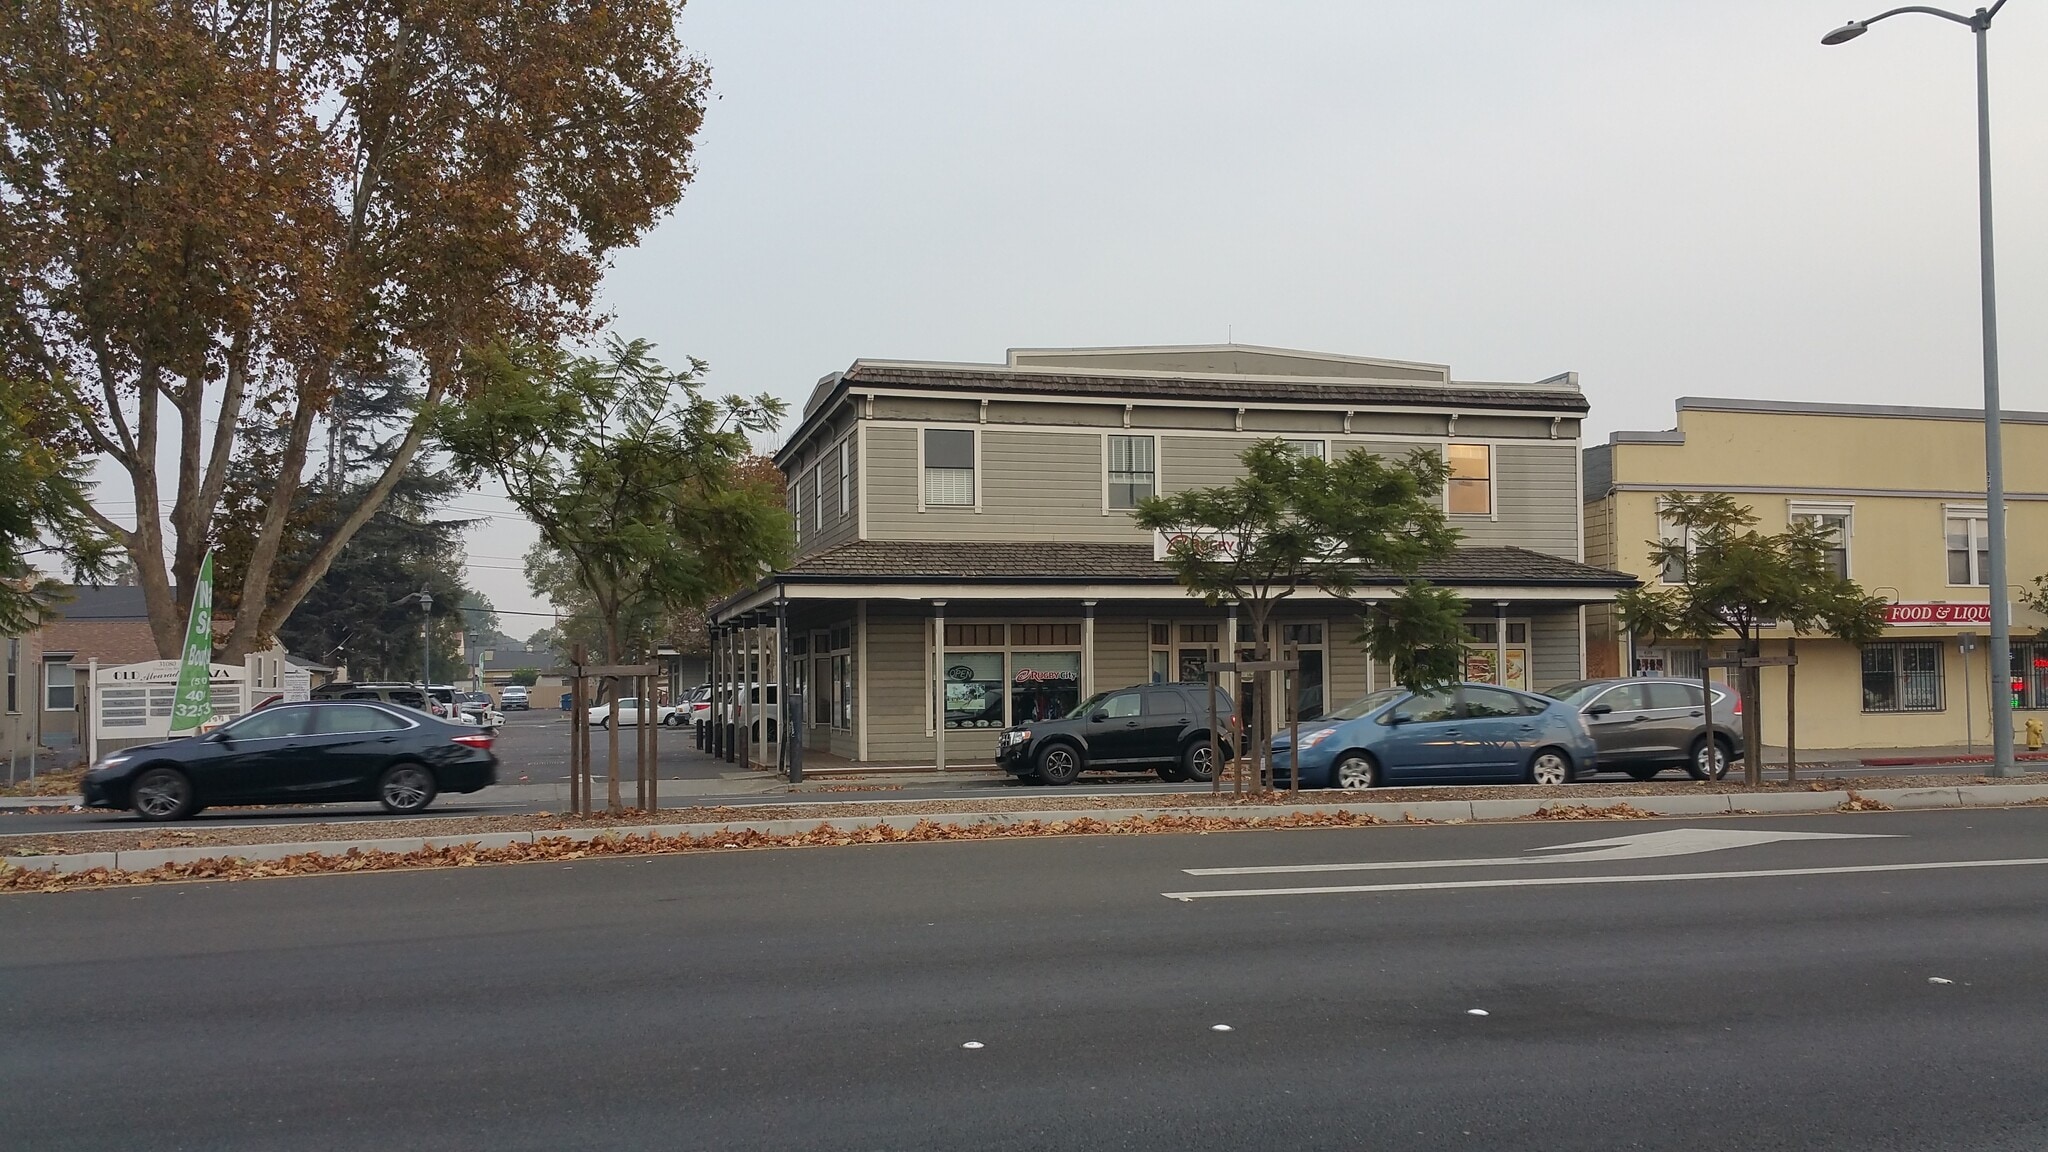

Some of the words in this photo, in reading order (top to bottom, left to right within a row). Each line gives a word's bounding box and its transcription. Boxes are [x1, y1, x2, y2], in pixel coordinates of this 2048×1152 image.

[1892, 607, 1931, 620] FOOD
[1936, 606, 1950, 619] &
[113, 671, 140, 680] OLD
[950, 668, 972, 680] OPEN
